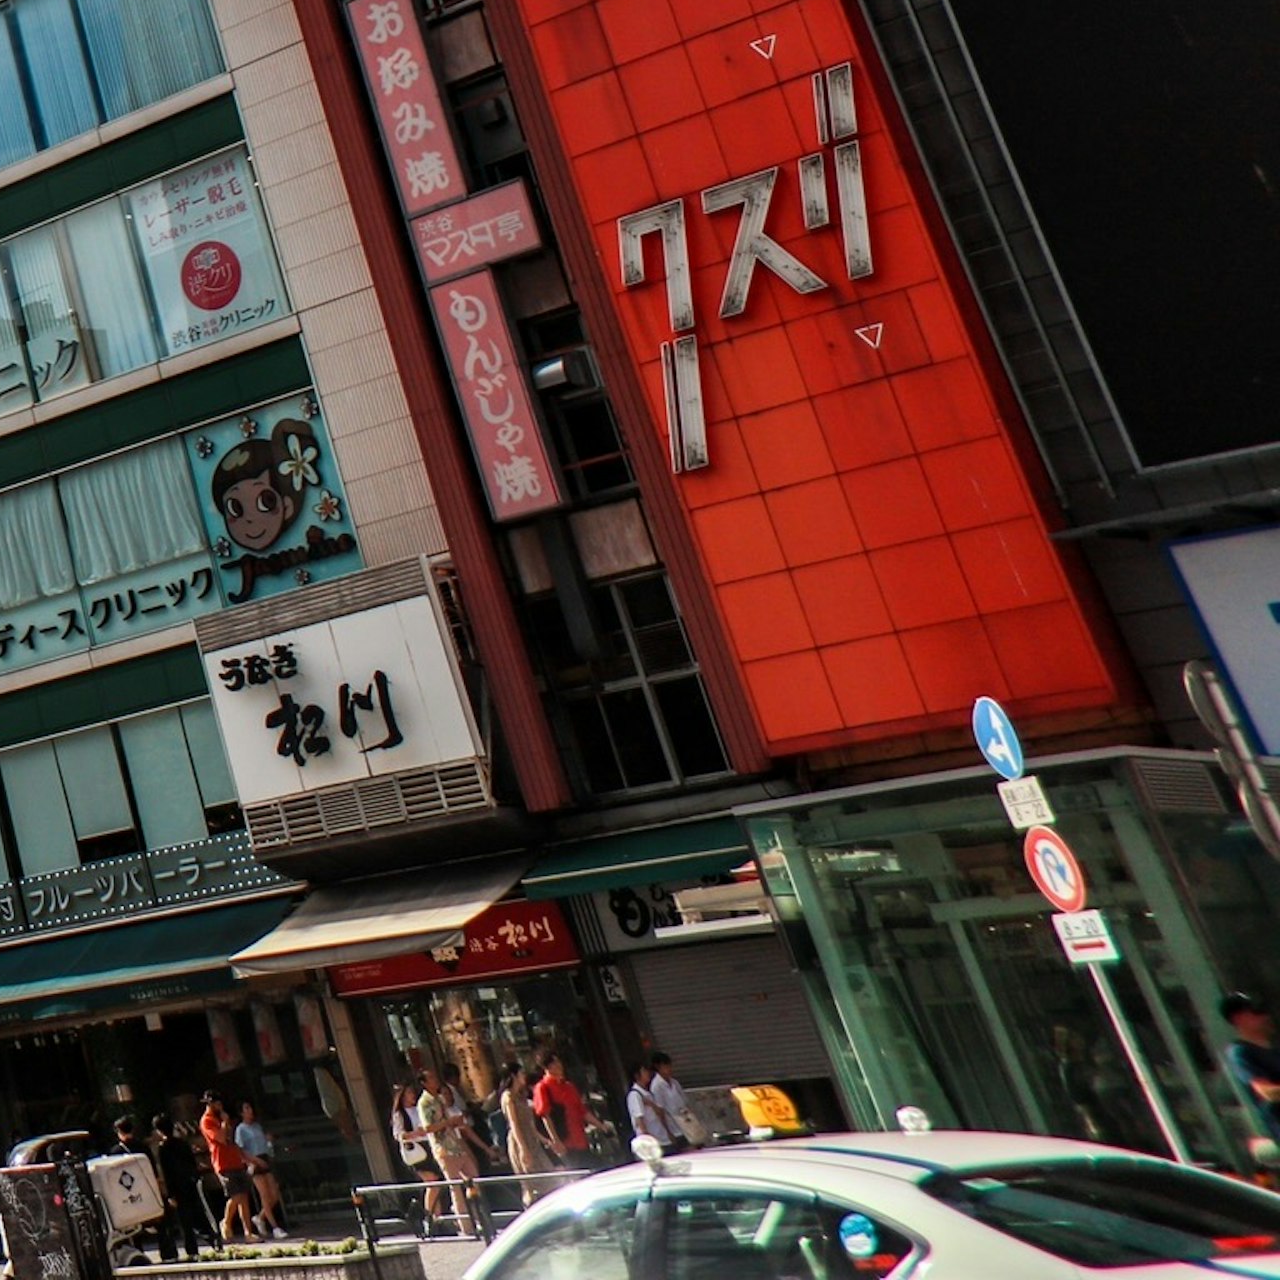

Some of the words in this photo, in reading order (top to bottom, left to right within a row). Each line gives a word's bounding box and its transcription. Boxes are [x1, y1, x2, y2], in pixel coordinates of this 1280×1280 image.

[365, 0, 451, 199] お好み焼
[144, 176, 243, 229] レーザー脱毛
[418, 213, 454, 240] 渋谷
[448, 289, 542, 504] もんじゃ焼
[219, 643, 301, 692] うなぎ
[266, 671, 406, 769] 松川
[26, 855, 228, 917] フルーツパーラー
[498, 915, 555, 947] 松川
